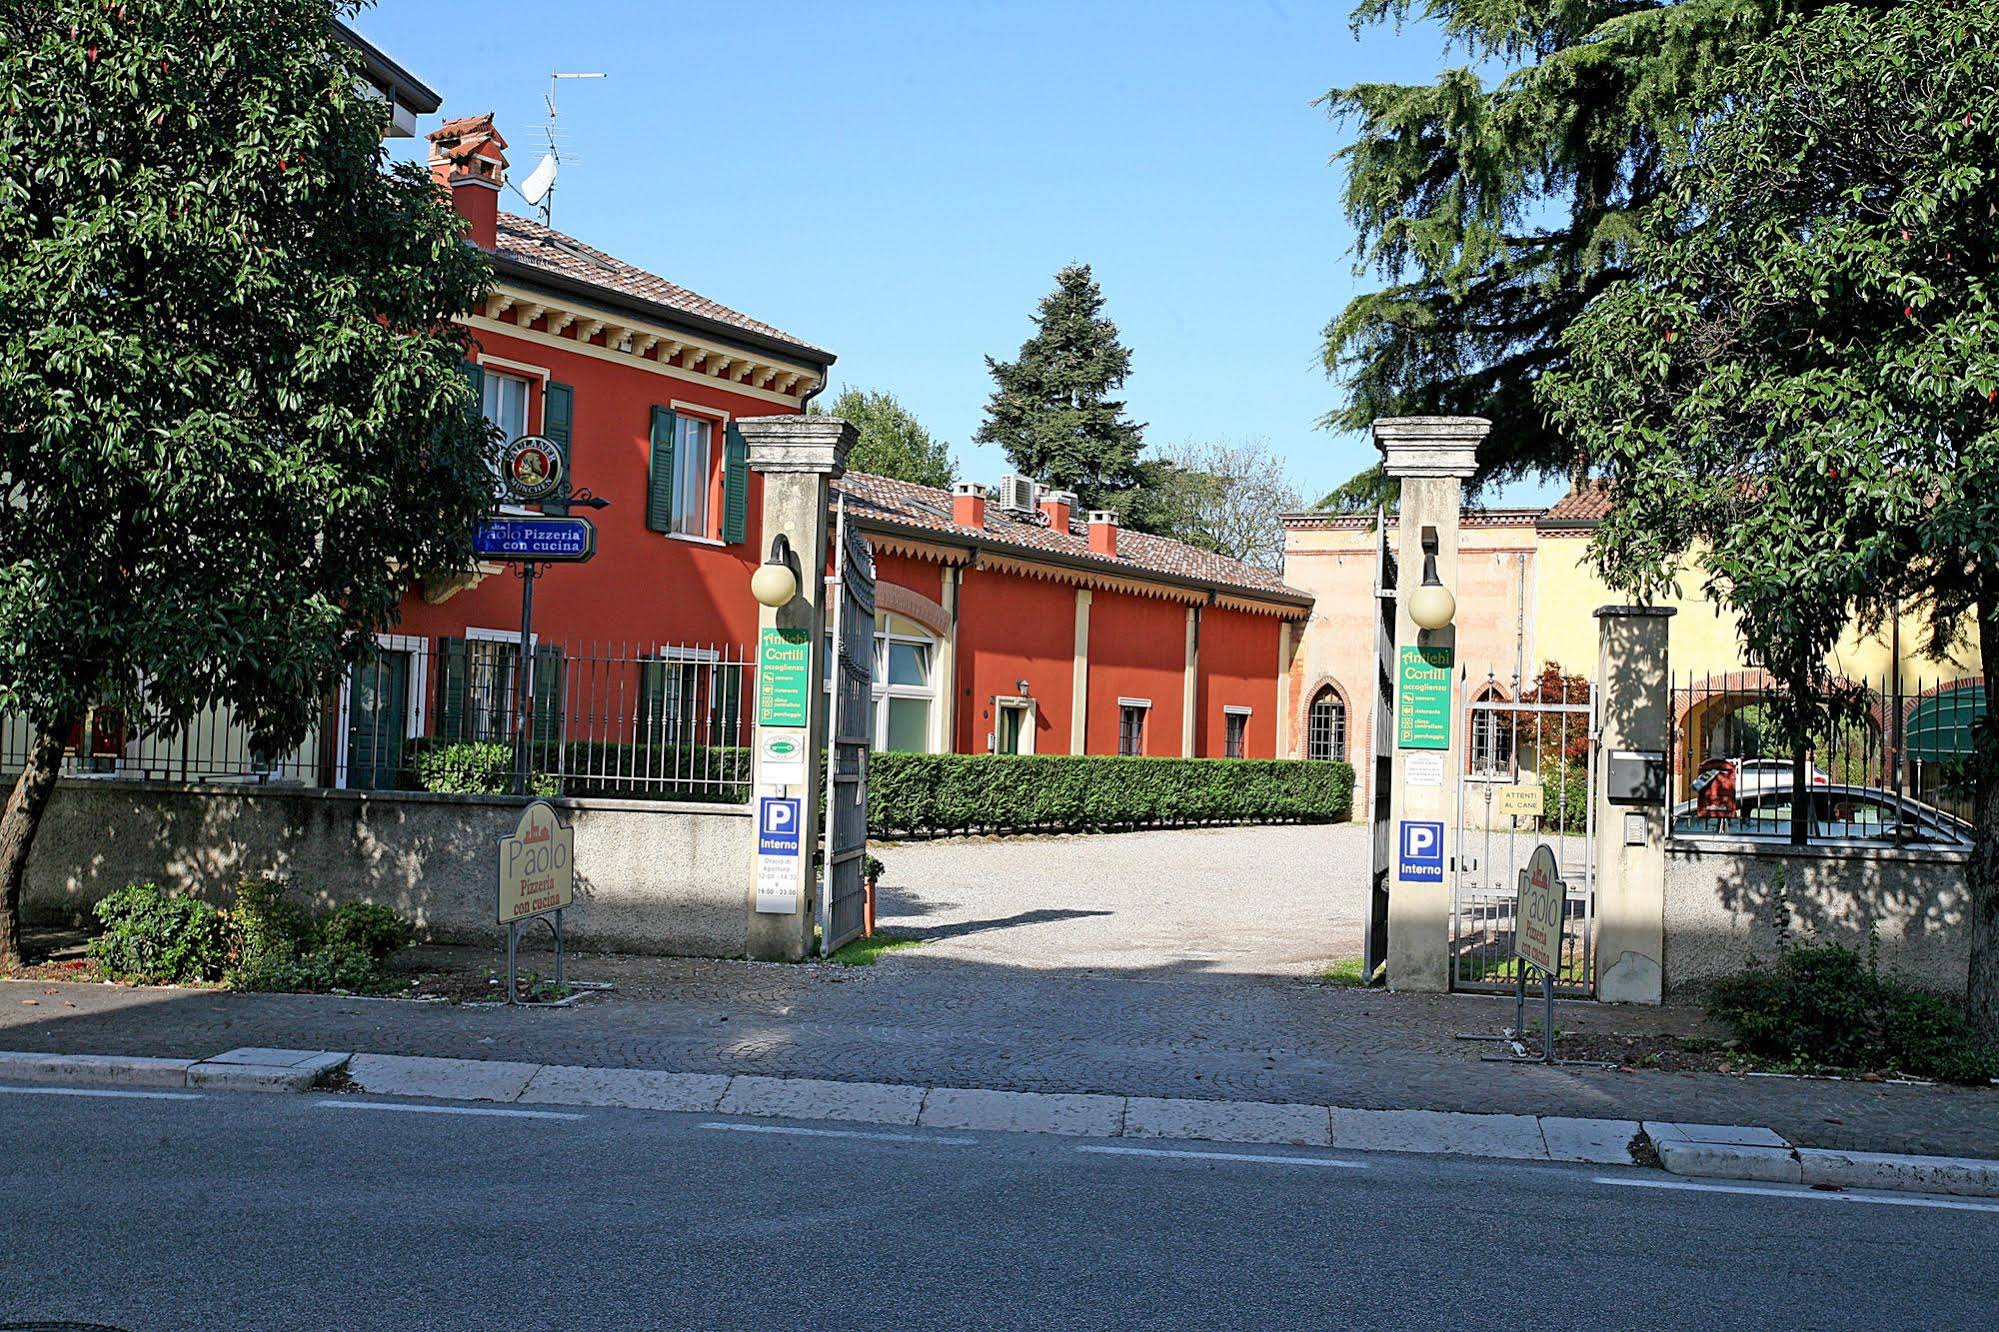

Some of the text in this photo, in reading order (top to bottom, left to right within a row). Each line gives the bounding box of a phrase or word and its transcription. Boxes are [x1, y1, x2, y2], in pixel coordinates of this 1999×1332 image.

[524, 529, 580, 540] Pizzeria
[503, 540, 580, 551] con cucina
[765, 647, 804, 661] Cortili
[1402, 651, 1450, 666] Antichi
[1404, 667, 1446, 680] Cortili
[1403, 683, 1447, 692] accoglienza
[769, 803, 791, 831] P
[761, 838, 797, 850] Interno
[1409, 827, 1433, 856] P
[509, 821, 566, 880] Paolo
[1401, 863, 1441, 875] Interno
[520, 874, 555, 897] Pizzeria
[513, 891, 561, 916] con cucina
[1521, 868, 1558, 928] Paolo
